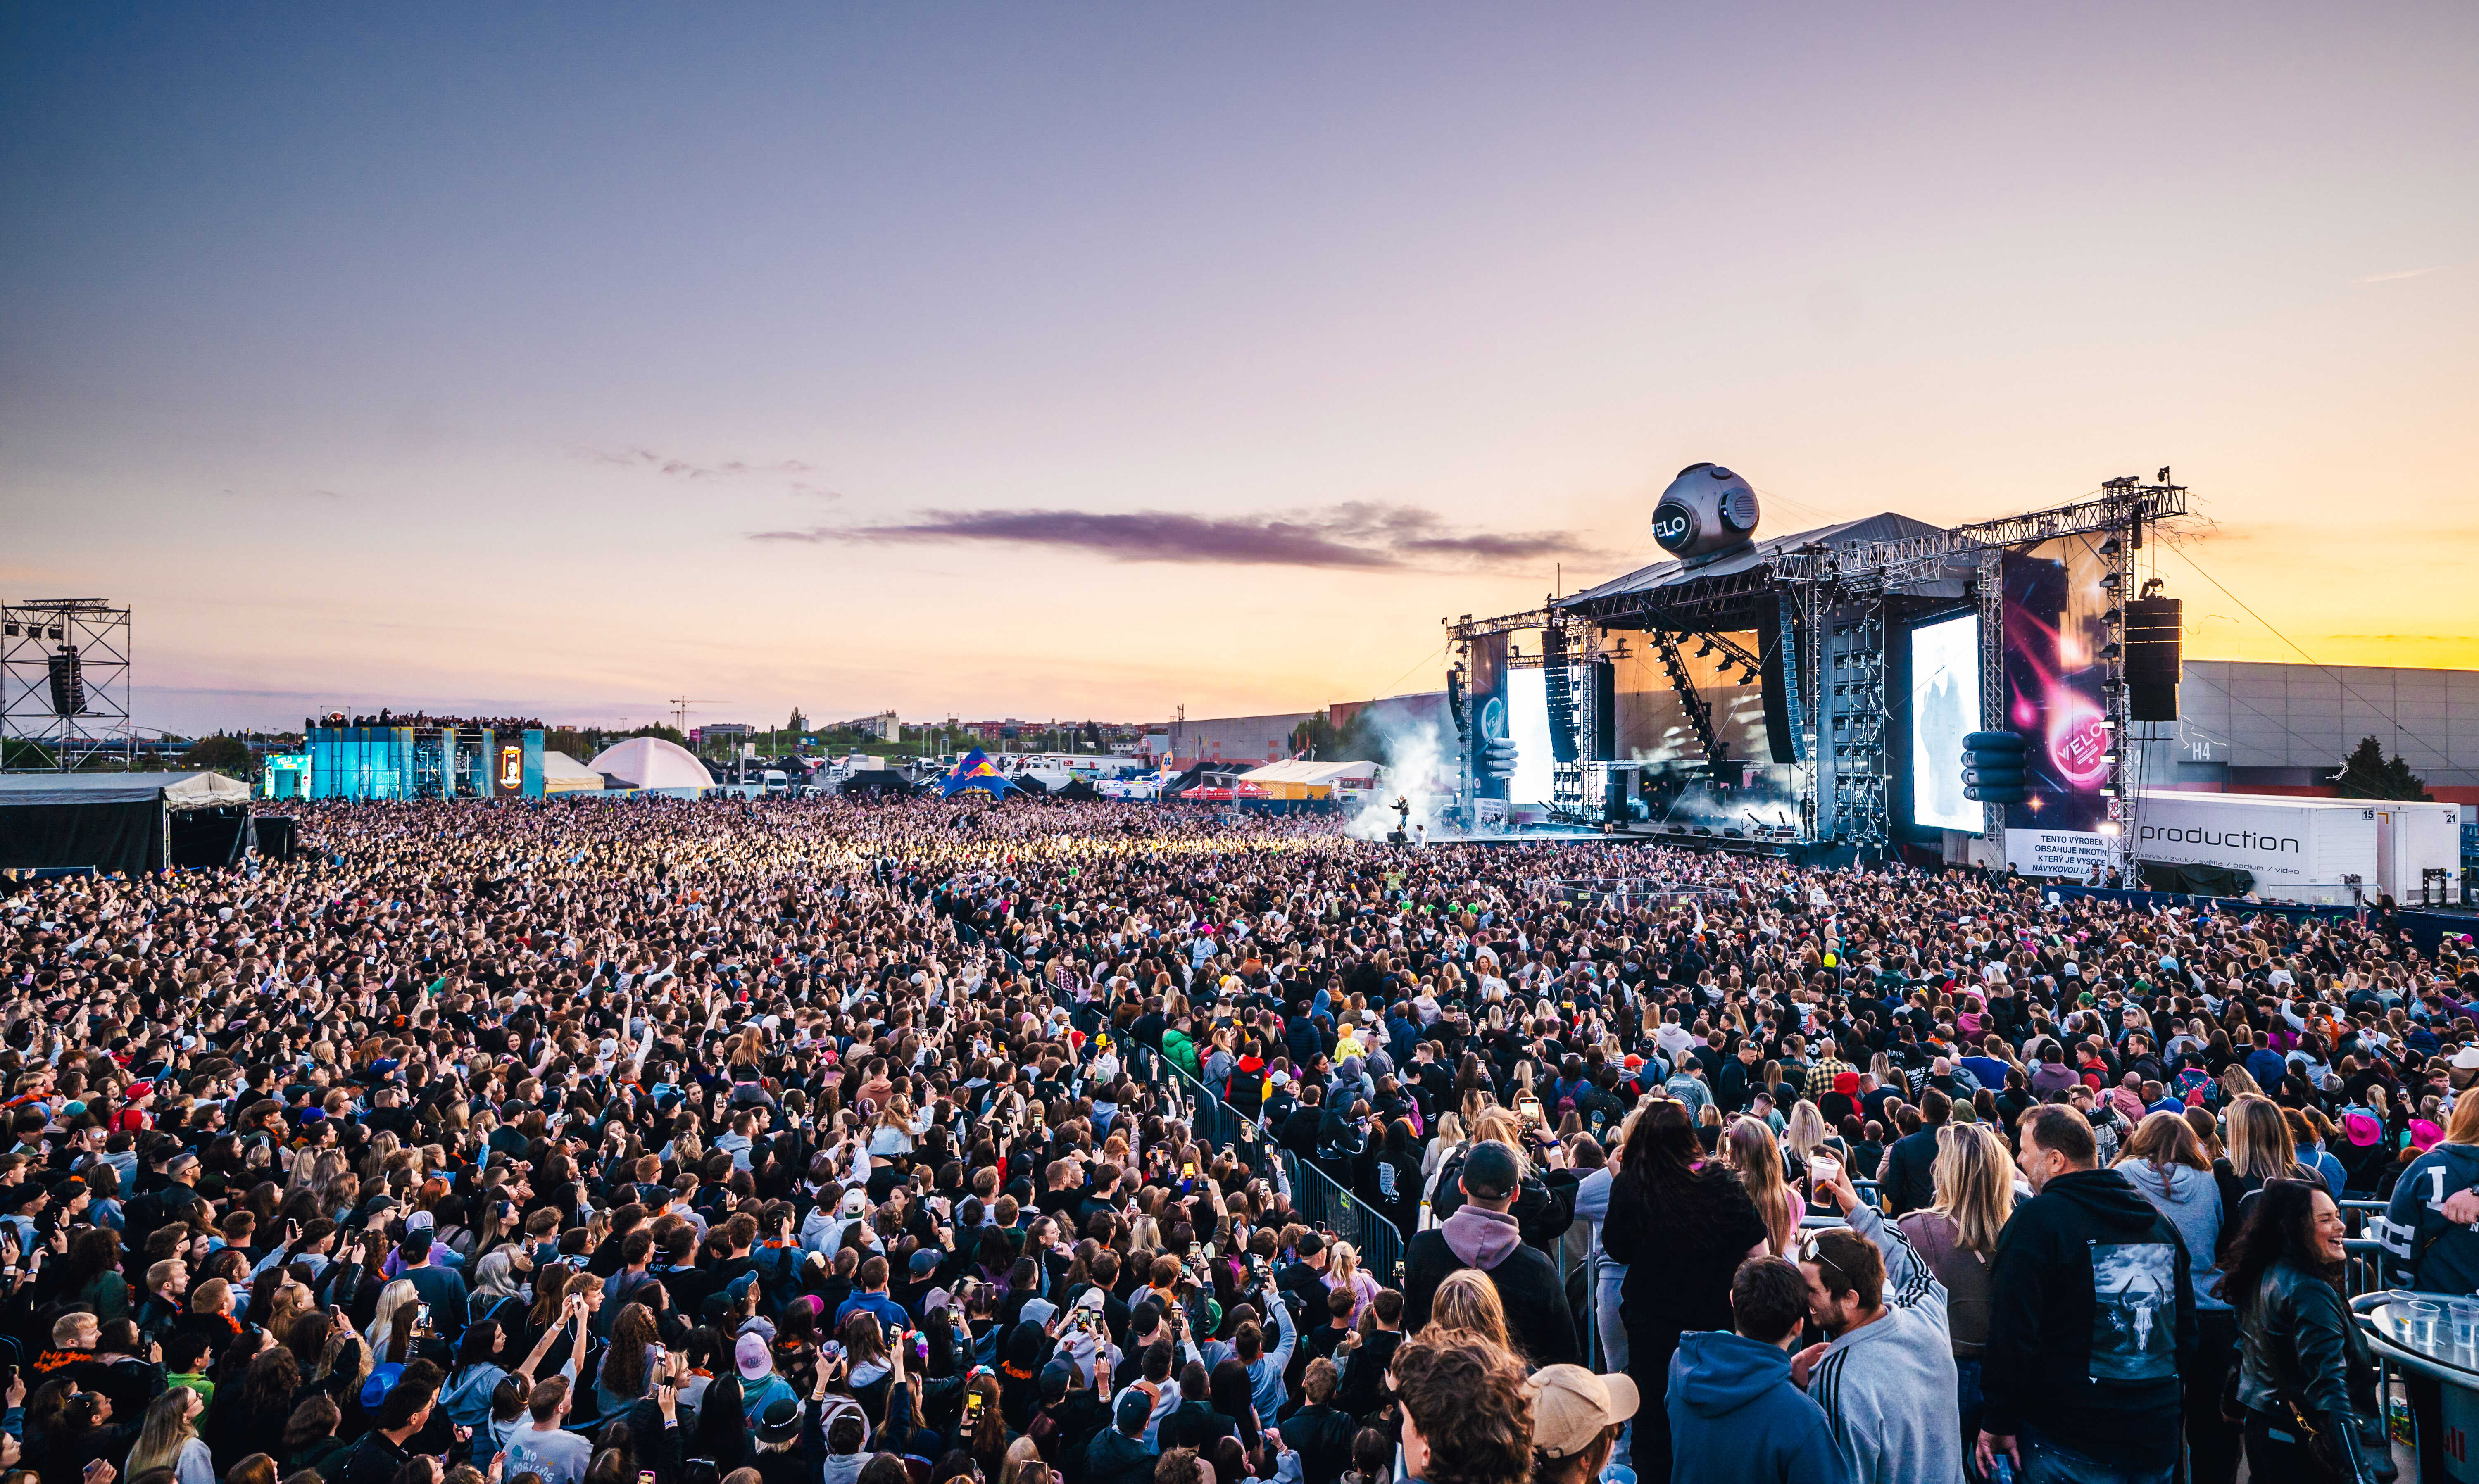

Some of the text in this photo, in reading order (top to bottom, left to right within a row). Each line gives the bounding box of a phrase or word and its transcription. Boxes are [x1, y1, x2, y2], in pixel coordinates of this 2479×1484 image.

[2058, 723, 2102, 761] VELO
[2193, 742, 2210, 760] H4
[276, 756, 293, 765] VELO
[2363, 810, 2373, 819] 15
[2447, 814, 2455, 823] 21
[2069, 835, 2103, 846] VÝROBEK
[2140, 826, 2298, 853] production
[2035, 845, 2077, 854] OBSAHUJE
[2038, 854, 2063, 863] KTERÝ
[2077, 857, 2105, 866] VYSOCE
[2032, 863, 2079, 873] NÁVYKOVOU
[2233, 863, 2263, 871] podium
[523, 1449, 537, 1462] NO
